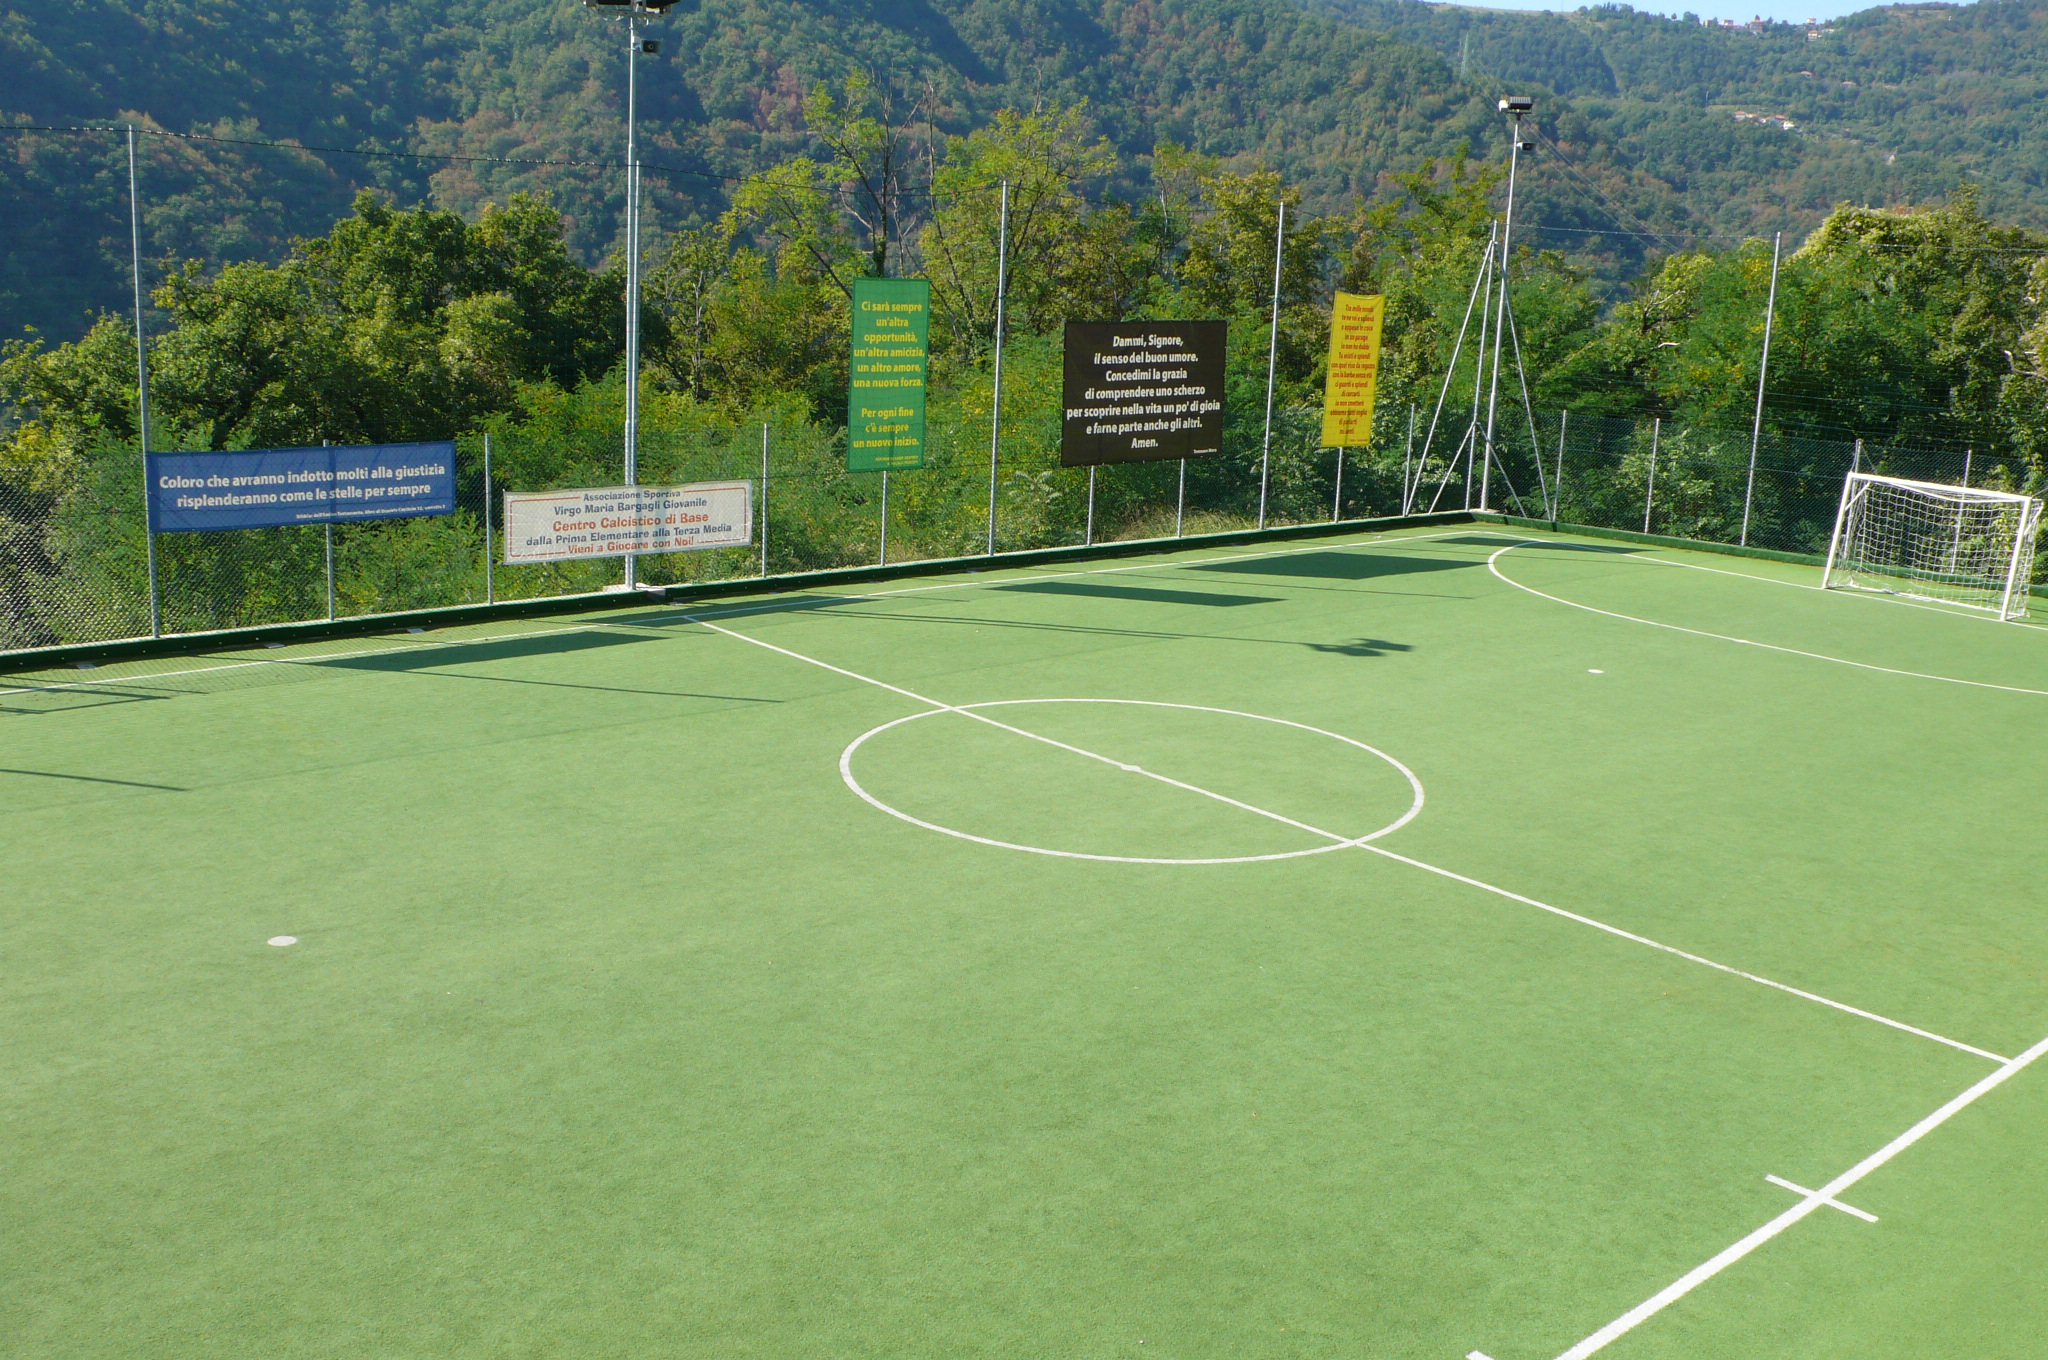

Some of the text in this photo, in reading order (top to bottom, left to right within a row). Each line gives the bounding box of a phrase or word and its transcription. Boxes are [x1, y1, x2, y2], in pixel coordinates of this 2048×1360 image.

[861, 300, 923, 314] Ci sarà sempre
[876, 316, 909, 327] un'altra
[864, 331, 918, 344] opportunità,
[1112, 333, 1184, 349] Dammi, Signore,
[853, 346, 925, 358] un'altra amicizia,
[1093, 351, 1199, 365] il senso del buon umore.
[857, 362, 921, 373] un altro amore,
[853, 376, 923, 388] una nuova forza.
[1105, 367, 1188, 383] Concedimi la grazia
[1084, 384, 1206, 401] di comprendere uno scherzo
[861, 406, 915, 420] Per ogni fine
[1066, 399, 1221, 421] per scoprire nella vita un po' di gioia
[865, 422, 909, 434] c'è sempre
[1086, 416, 1203, 436] e farne parte anche gli altri.
[853, 435, 919, 448] un nuovo inizio.
[1131, 437, 1159, 449] Amen.
[160, 463, 446, 489] Coloro che avranno indotto molti alla giustizia
[177, 484, 431, 510] risplenderanno come le stelle per sempre
[583, 490, 681, 502] Associazione Sportiva
[554, 498, 708, 517] Virgo Maria Bargagli Giovanile
[552, 512, 709, 532] Centro Calcistico di Base
[526, 523, 732, 546] dalla Prima Elementare alla Terza Media
[568, 544, 594, 554] Vieni
[607, 541, 649, 551] Giocare
[652, 541, 671, 549] con
[674, 536, 695, 547] Noi!
